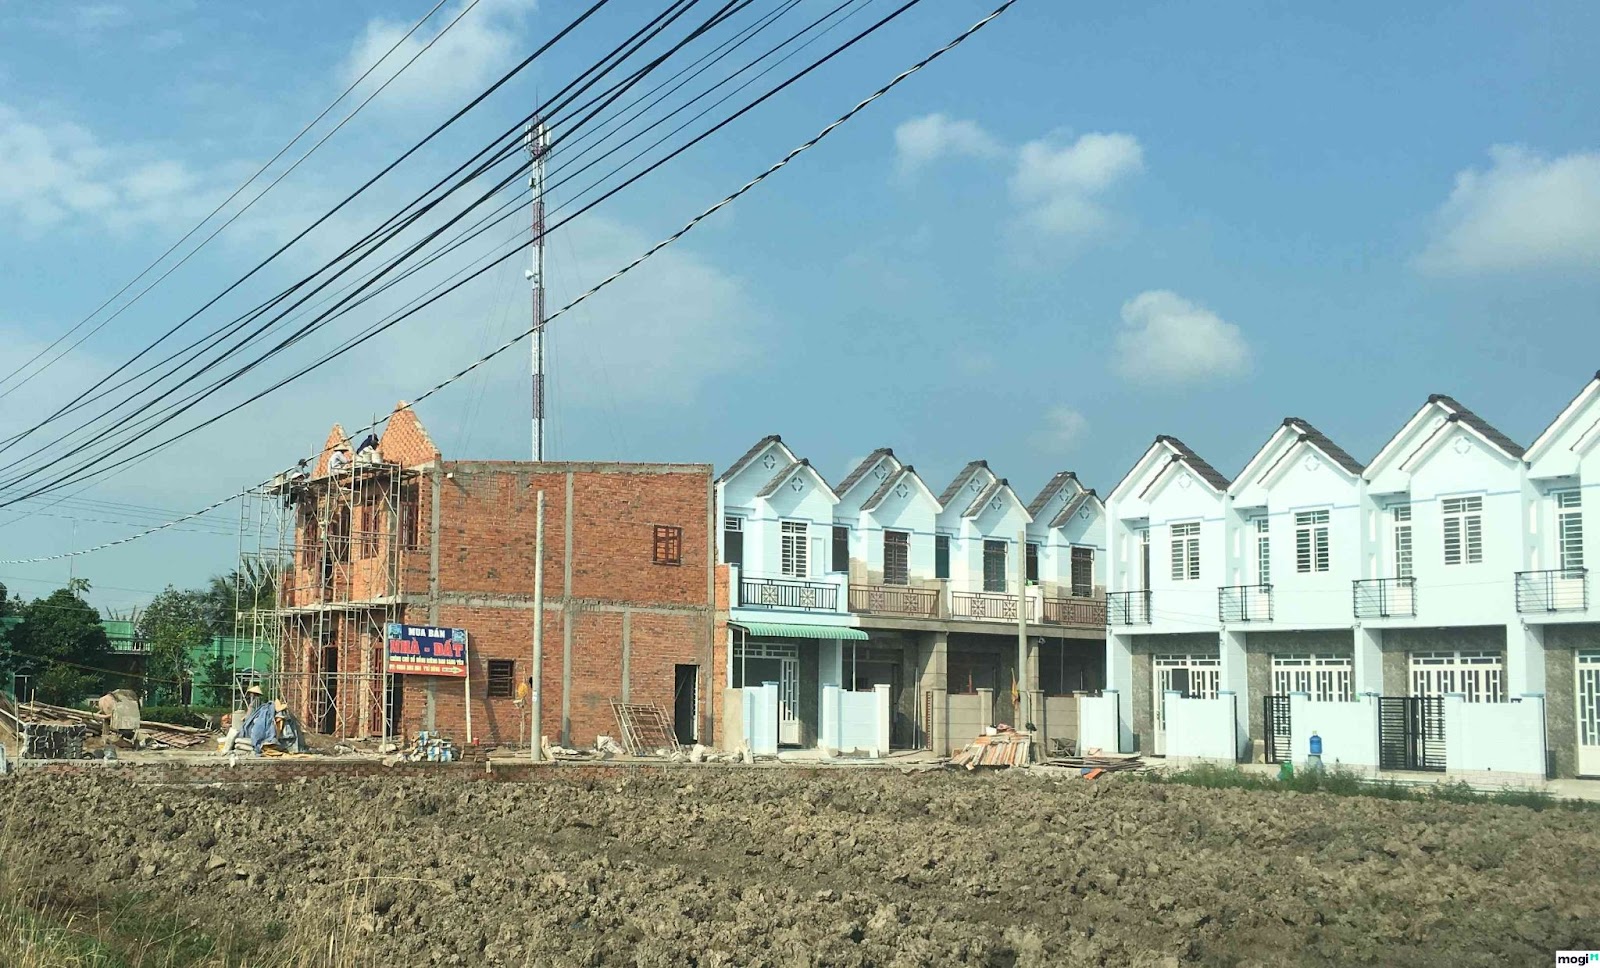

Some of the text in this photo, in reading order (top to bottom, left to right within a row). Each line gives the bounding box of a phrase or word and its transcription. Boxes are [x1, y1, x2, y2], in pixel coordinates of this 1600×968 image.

[408, 627, 445, 638] MUA BÁN
[390, 637, 420, 655] NHÀ
[433, 638, 463, 657] ĐẤT
